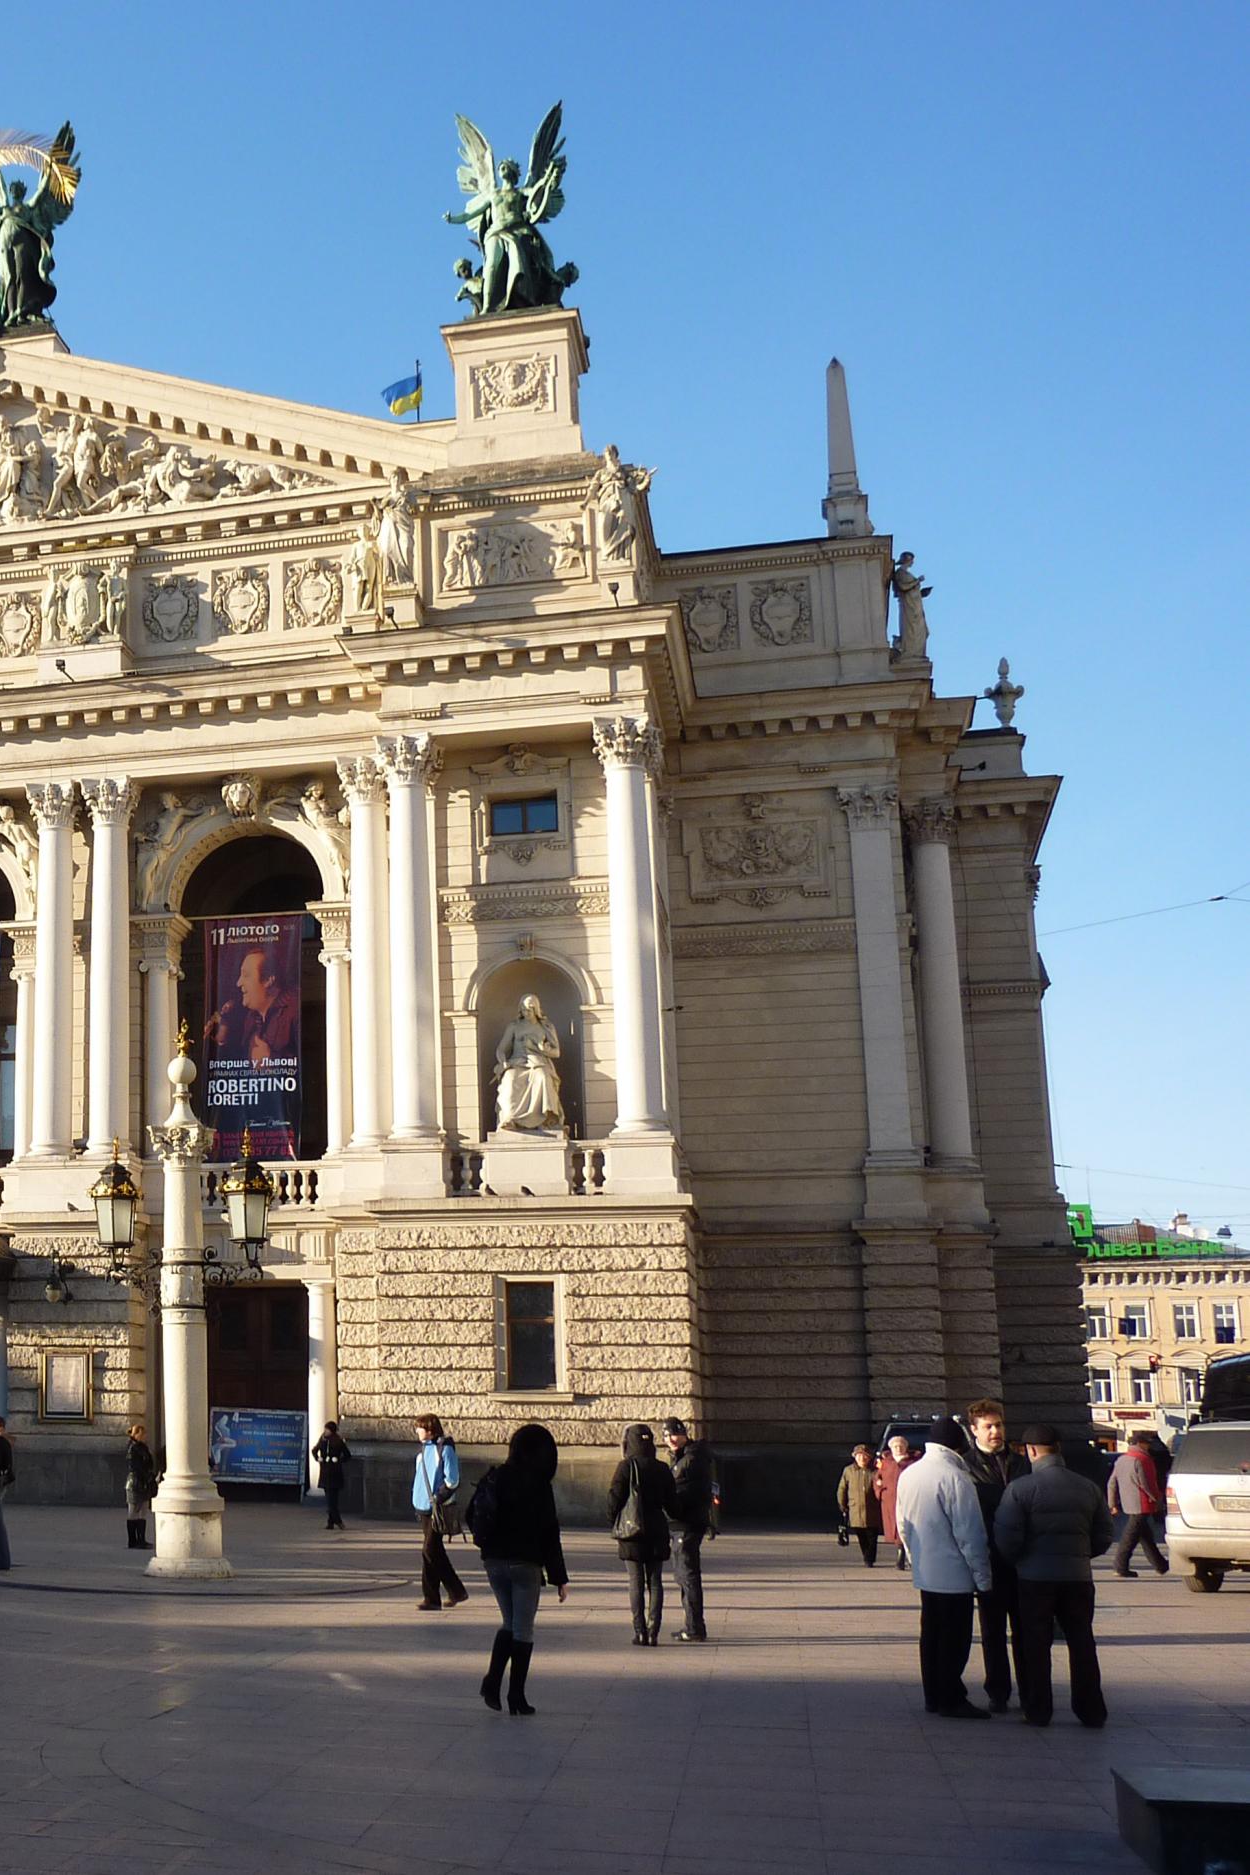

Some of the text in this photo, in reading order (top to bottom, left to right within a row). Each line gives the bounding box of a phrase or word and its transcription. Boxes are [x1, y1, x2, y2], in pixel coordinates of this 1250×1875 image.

[211, 928, 225, 945] 11
[260, 1057, 297, 1067] Львові
[208, 1077, 296, 1094] ROBERTINO
[207, 1093, 258, 1107] LORETTI
